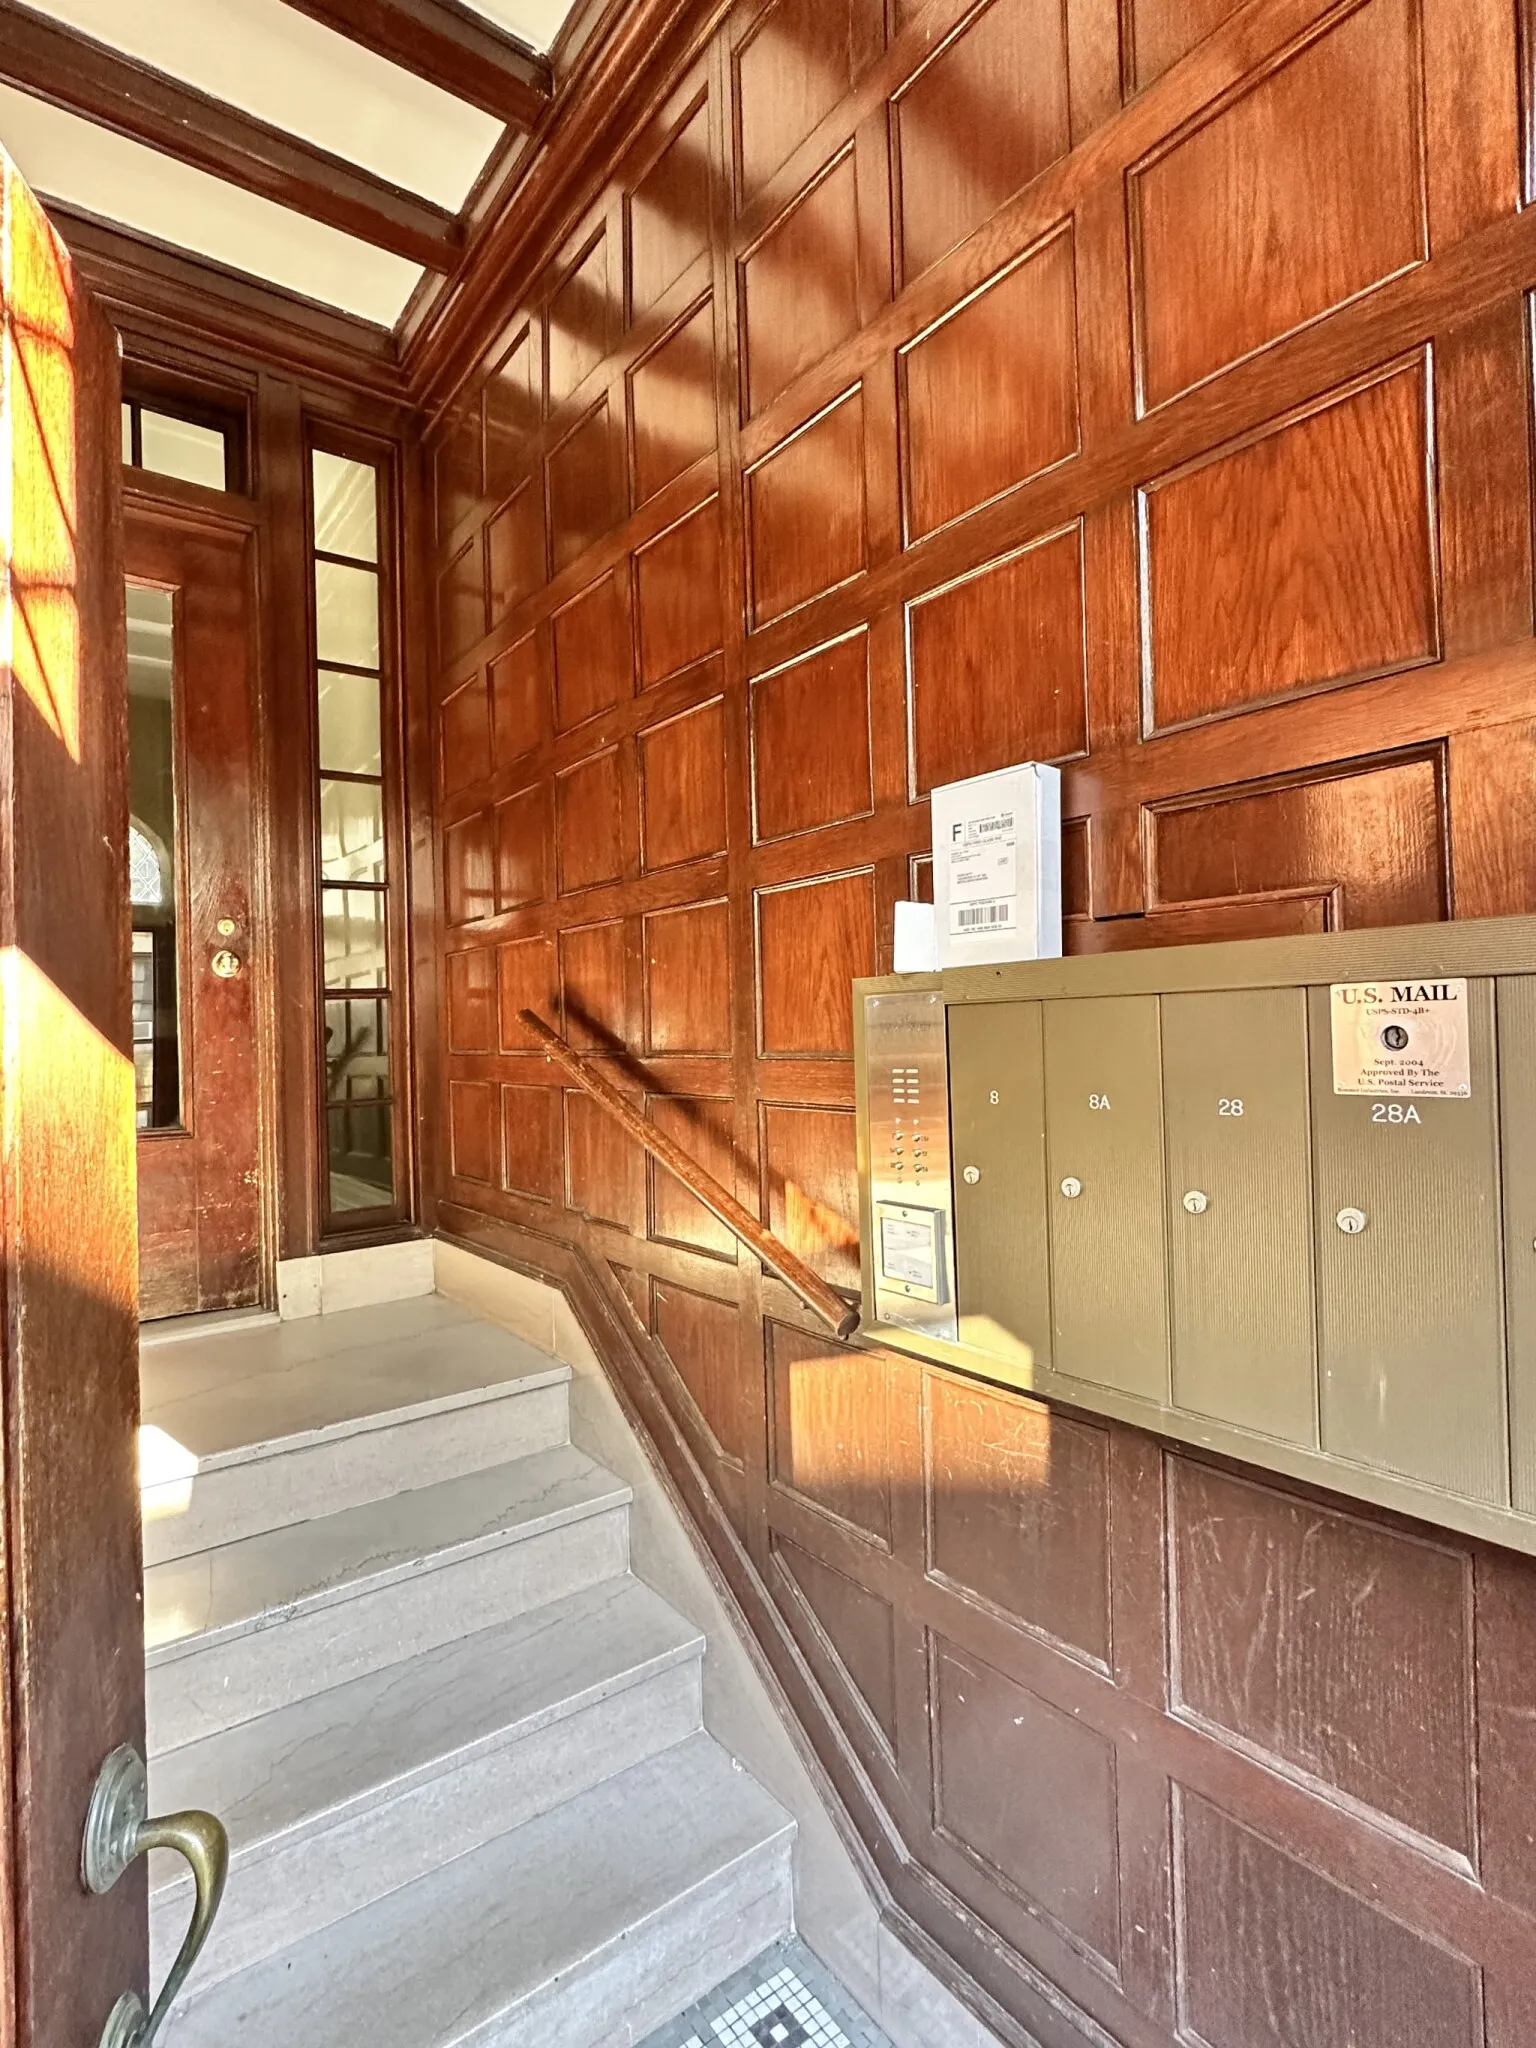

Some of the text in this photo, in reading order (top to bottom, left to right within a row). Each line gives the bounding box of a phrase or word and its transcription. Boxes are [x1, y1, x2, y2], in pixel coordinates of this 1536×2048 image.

[953, 823, 962, 842] F
[1342, 984, 1457, 1004] U.S. MAIL
[1374, 1059, 1397, 1067] Sept.
[1361, 1068, 1440, 1077] Approved By The
[989, 1090, 1000, 1104] 8
[1089, 1094, 1111, 1110] 8A
[1218, 1099, 1244, 1116] 28
[1372, 1104, 1421, 1124] 28A
